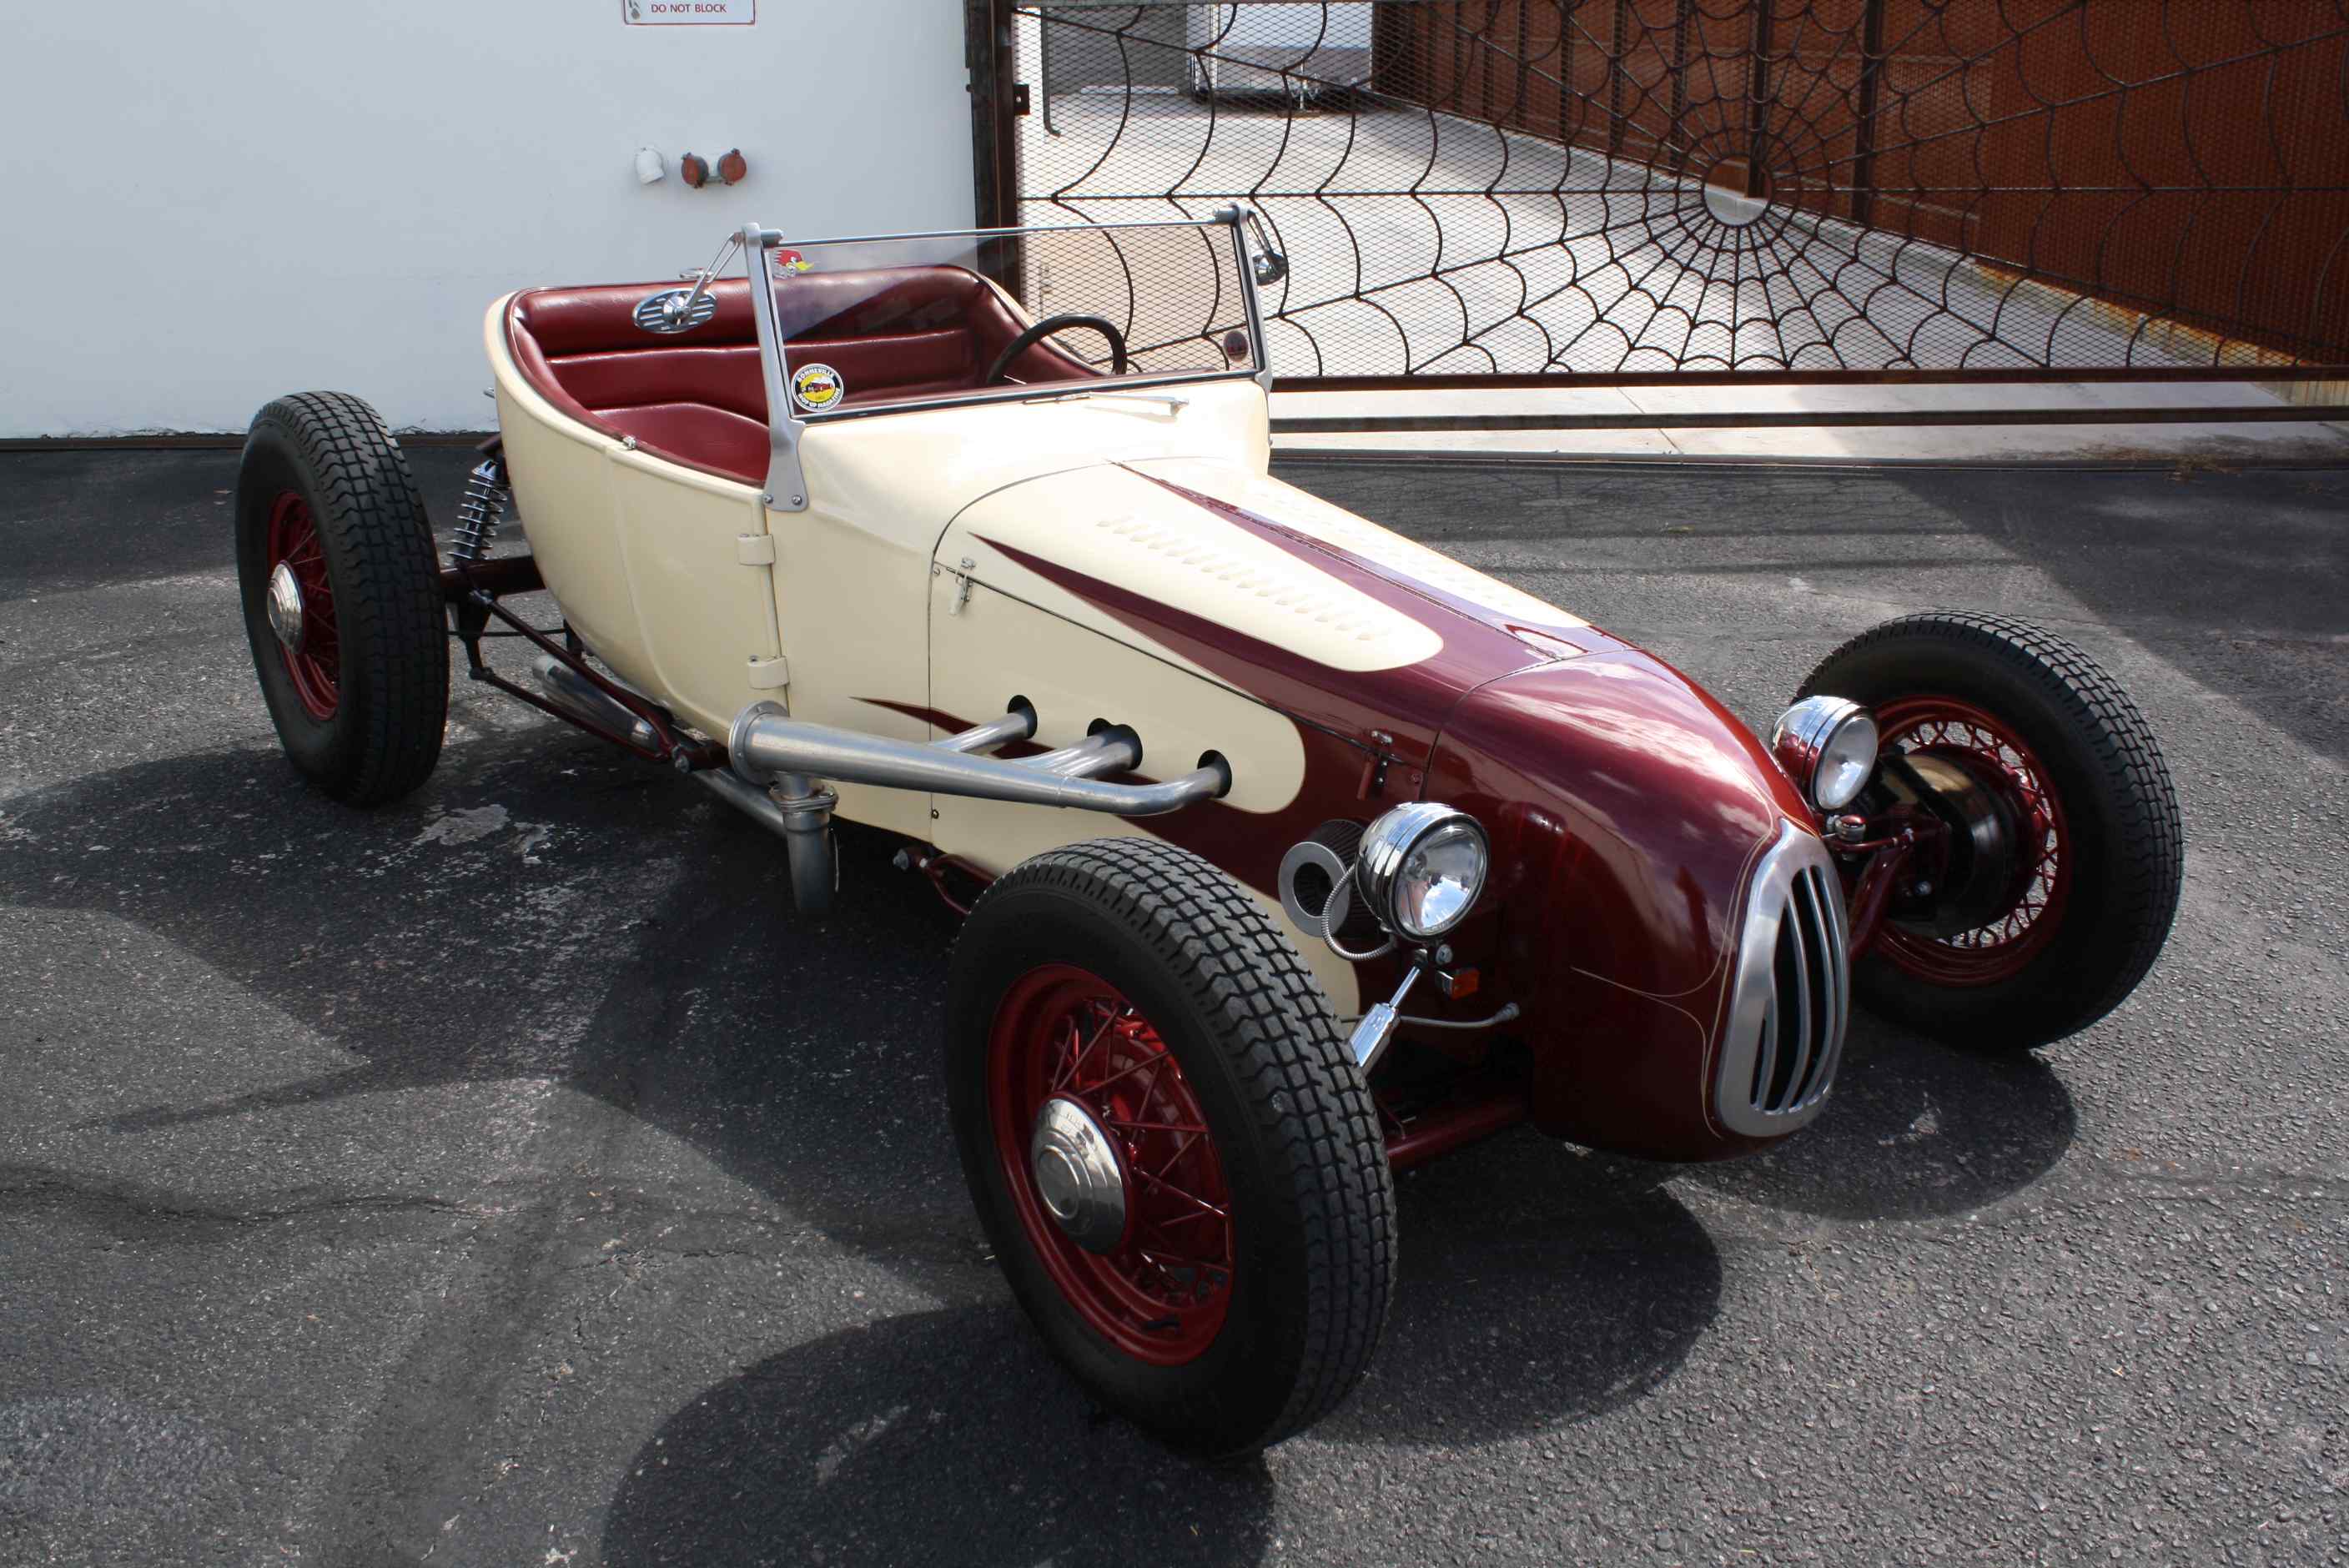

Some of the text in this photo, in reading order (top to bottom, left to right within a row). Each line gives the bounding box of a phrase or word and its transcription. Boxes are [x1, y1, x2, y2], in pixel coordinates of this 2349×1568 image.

[651, 3, 727, 13] DO NOT BLOCK
